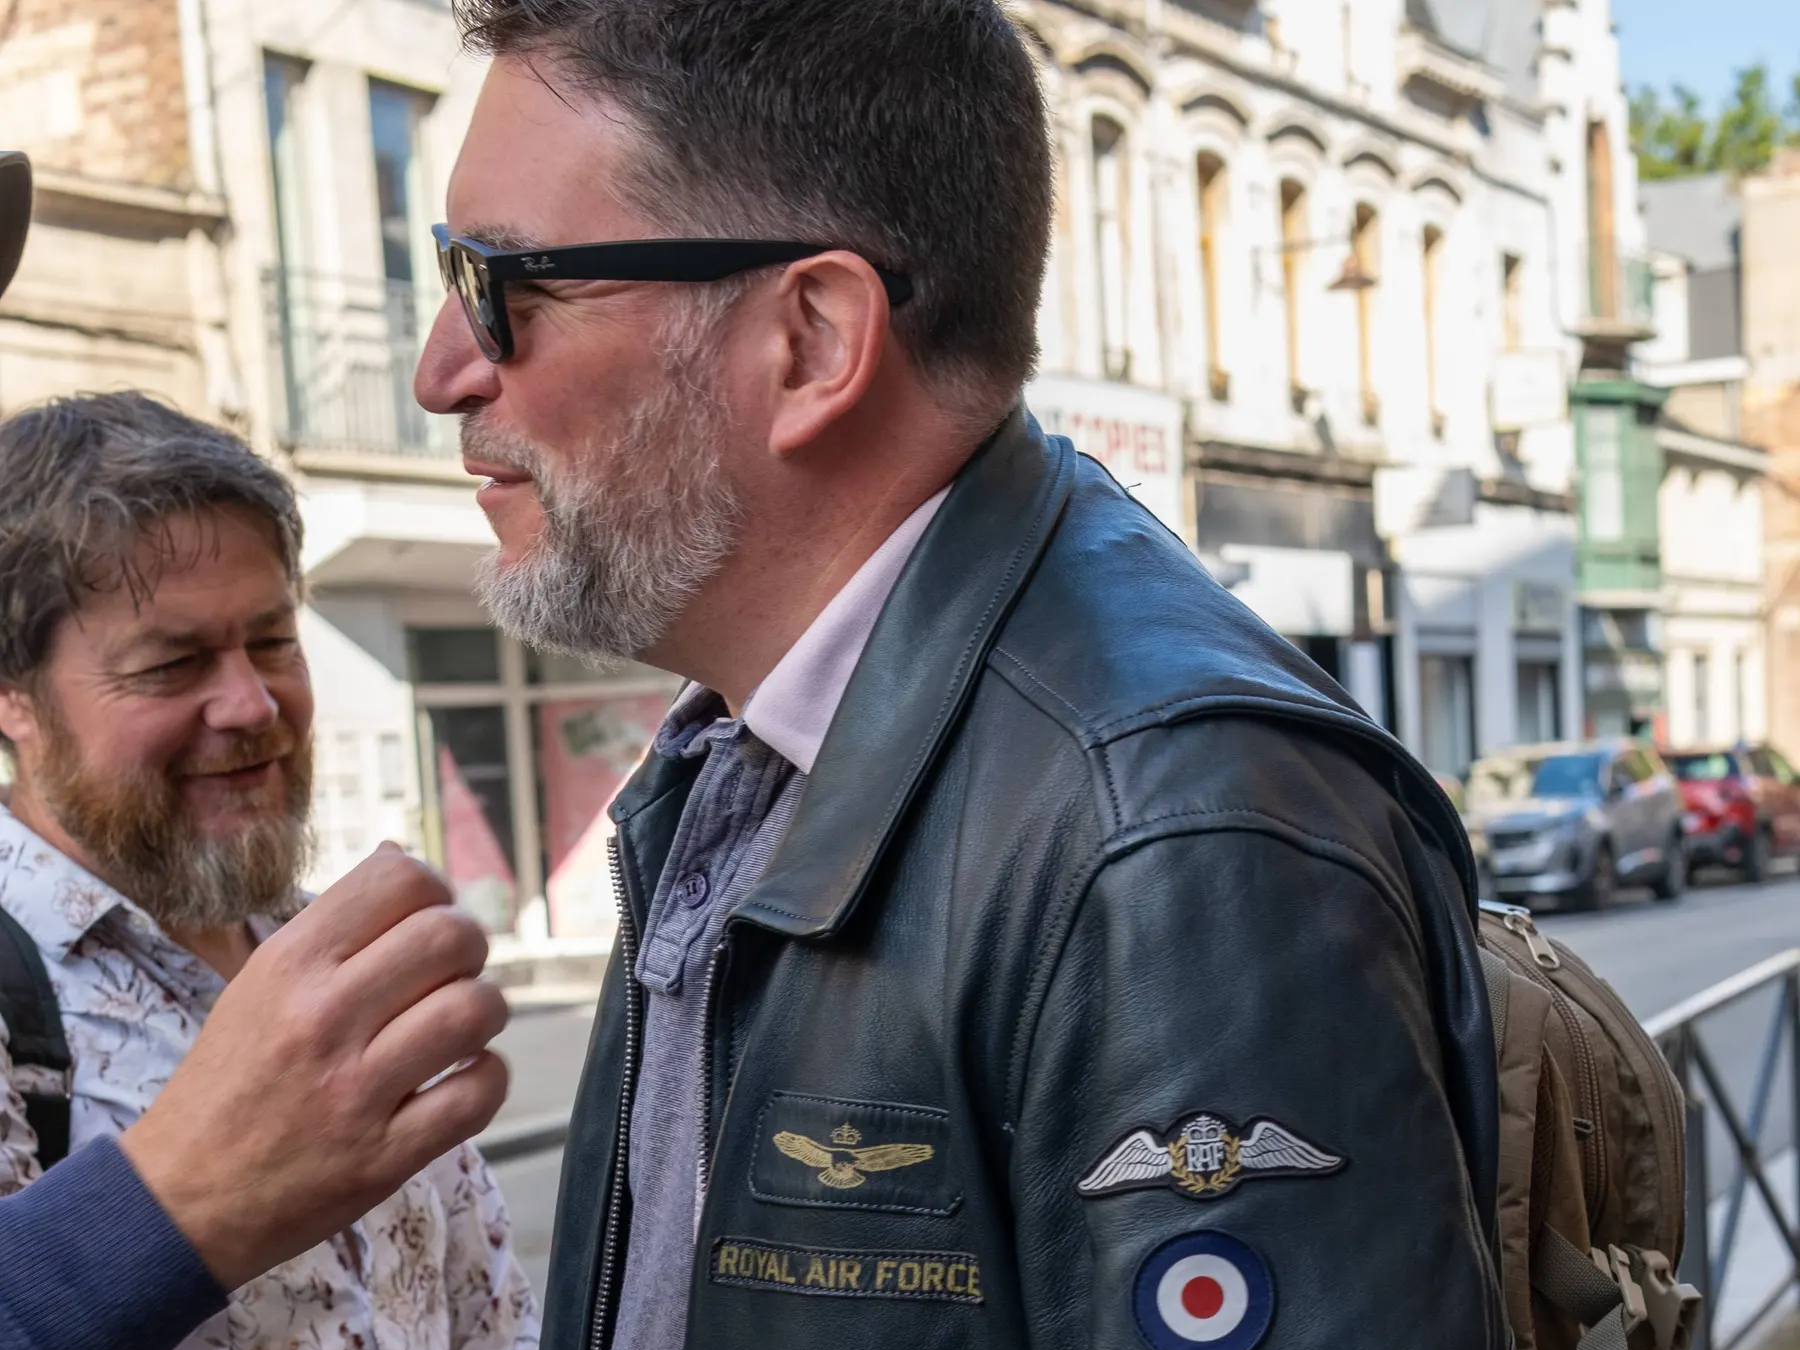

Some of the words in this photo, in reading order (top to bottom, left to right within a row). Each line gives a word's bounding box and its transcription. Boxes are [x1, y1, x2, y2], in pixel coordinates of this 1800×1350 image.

[1186, 1141, 1225, 1172] RAF
[718, 1245, 796, 1283] ROYAL
[805, 1257, 861, 1290] AIR
[875, 1260, 982, 1297] FORCE
